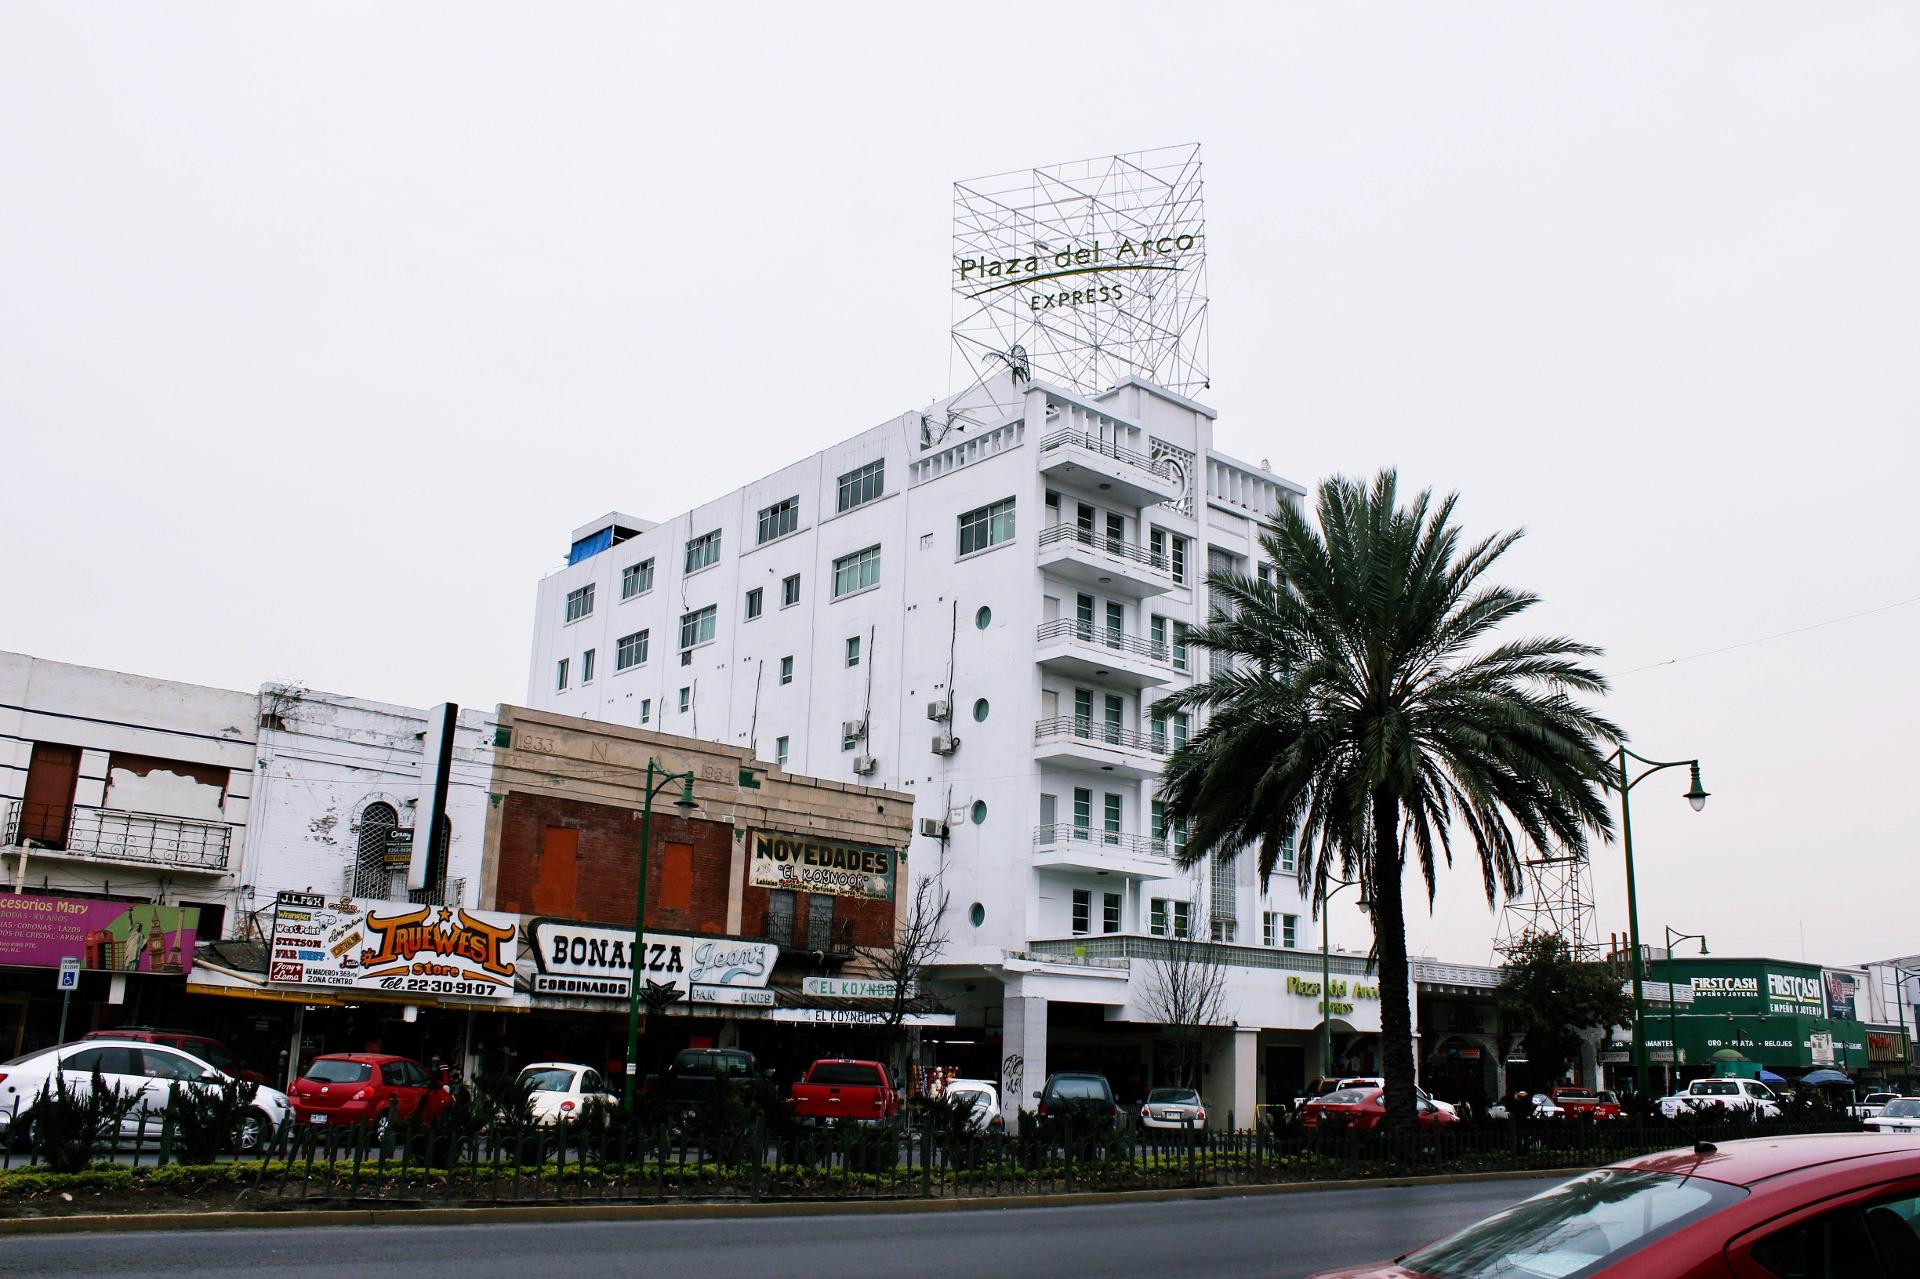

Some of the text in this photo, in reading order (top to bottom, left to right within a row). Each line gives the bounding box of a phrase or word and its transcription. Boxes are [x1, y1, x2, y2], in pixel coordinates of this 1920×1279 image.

[960, 234, 1195, 281] Plaza del Arco
[1031, 285, 1123, 311] EXPRESS
[756, 837, 888, 875] NOVEDADES
[57, 902, 89, 914] Mary
[17, 923, 52, 931] CORONAS
[276, 924, 320, 935] West Point
[26, 932, 55, 940] CRISTAL
[275, 937, 322, 948] STETSON
[275, 949, 325, 961] FAR WEST
[313, 969, 335, 977] MADERO
[412, 961, 460, 977] store
[307, 975, 353, 985] ZONA CENTRO
[539, 979, 627, 994] CORDINADOS
[820, 981, 836, 994] EL
[1287, 976, 1321, 997] Plaza
[816, 1010, 827, 1021] EL
